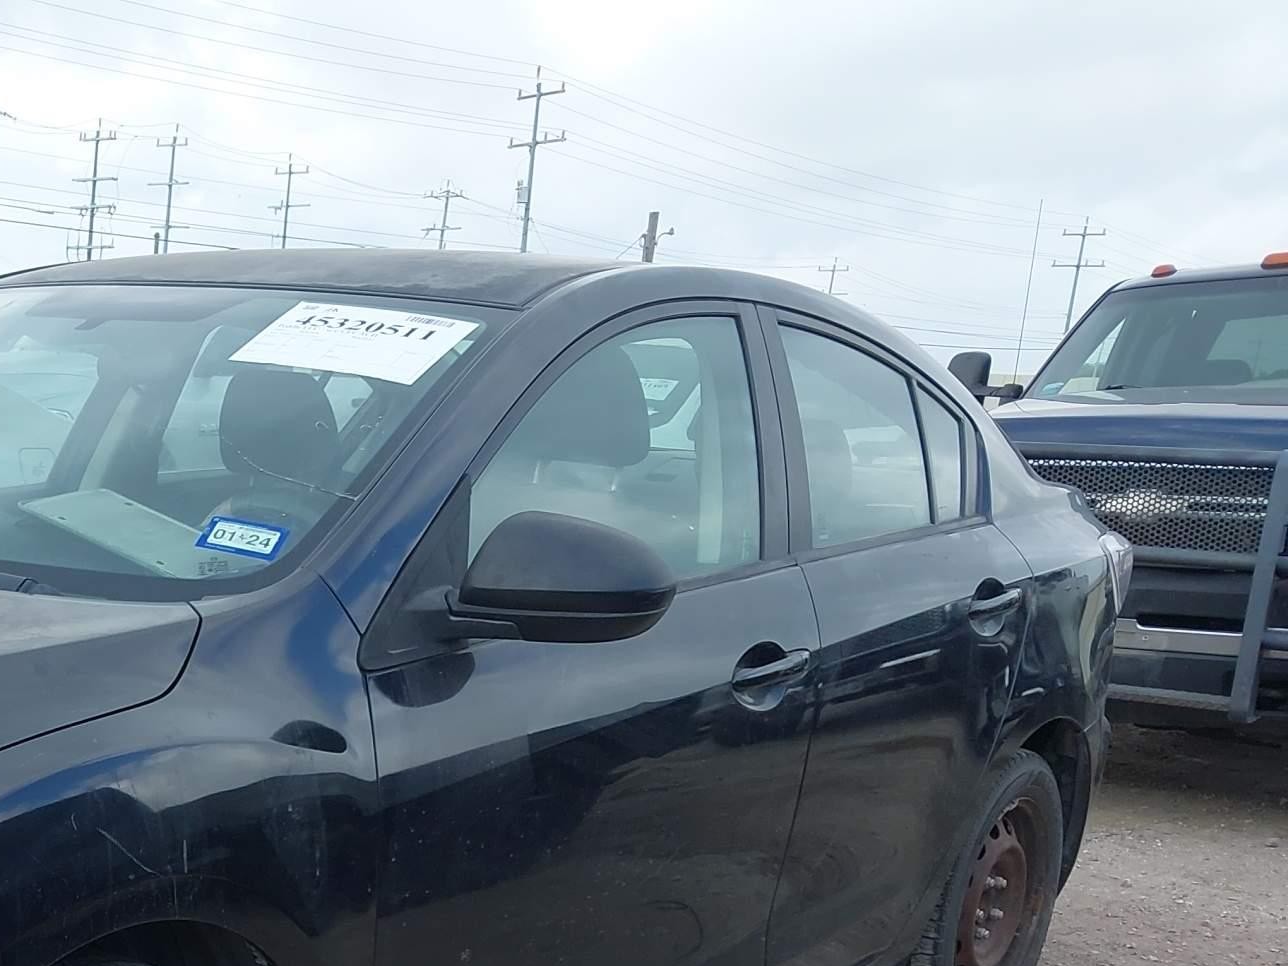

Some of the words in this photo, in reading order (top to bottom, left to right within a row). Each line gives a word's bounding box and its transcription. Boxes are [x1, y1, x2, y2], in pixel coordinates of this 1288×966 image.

[295, 314, 437, 341] 45320511
[213, 528, 237, 542] 01
[245, 534, 273, 549] 24
